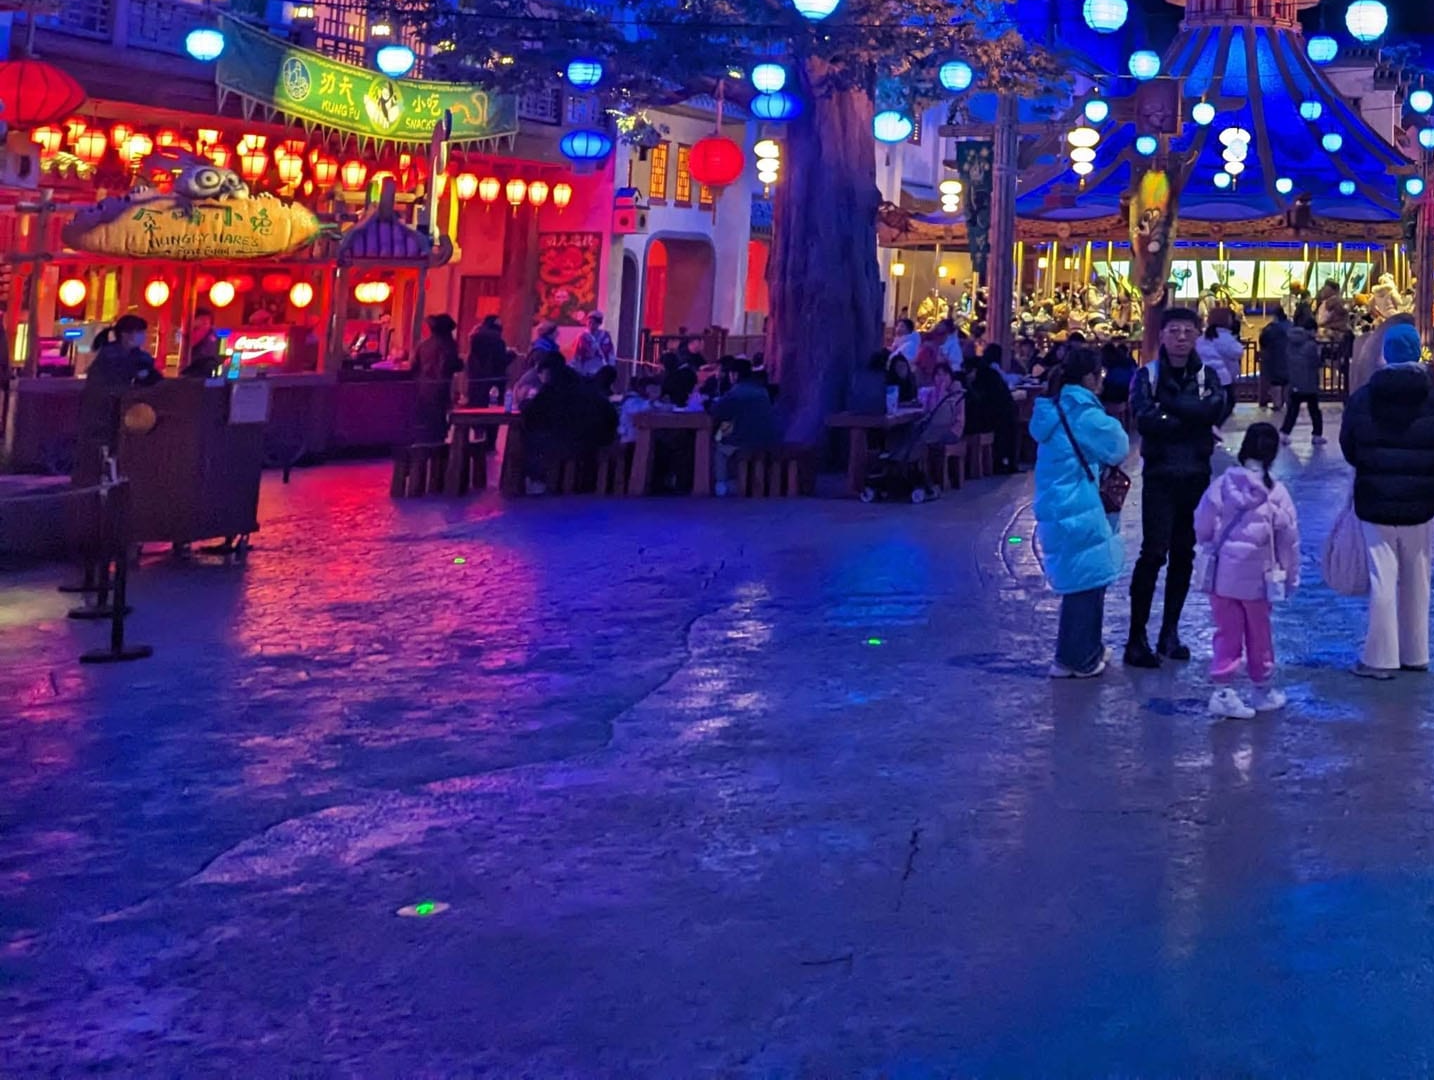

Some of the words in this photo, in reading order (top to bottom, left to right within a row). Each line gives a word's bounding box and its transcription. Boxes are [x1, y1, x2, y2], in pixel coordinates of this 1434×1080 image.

[319, 71, 355, 106] 功夫
[321, 99, 348, 117] KUNG
[349, 106, 361, 121] FU
[412, 92, 441, 116] 小吃
